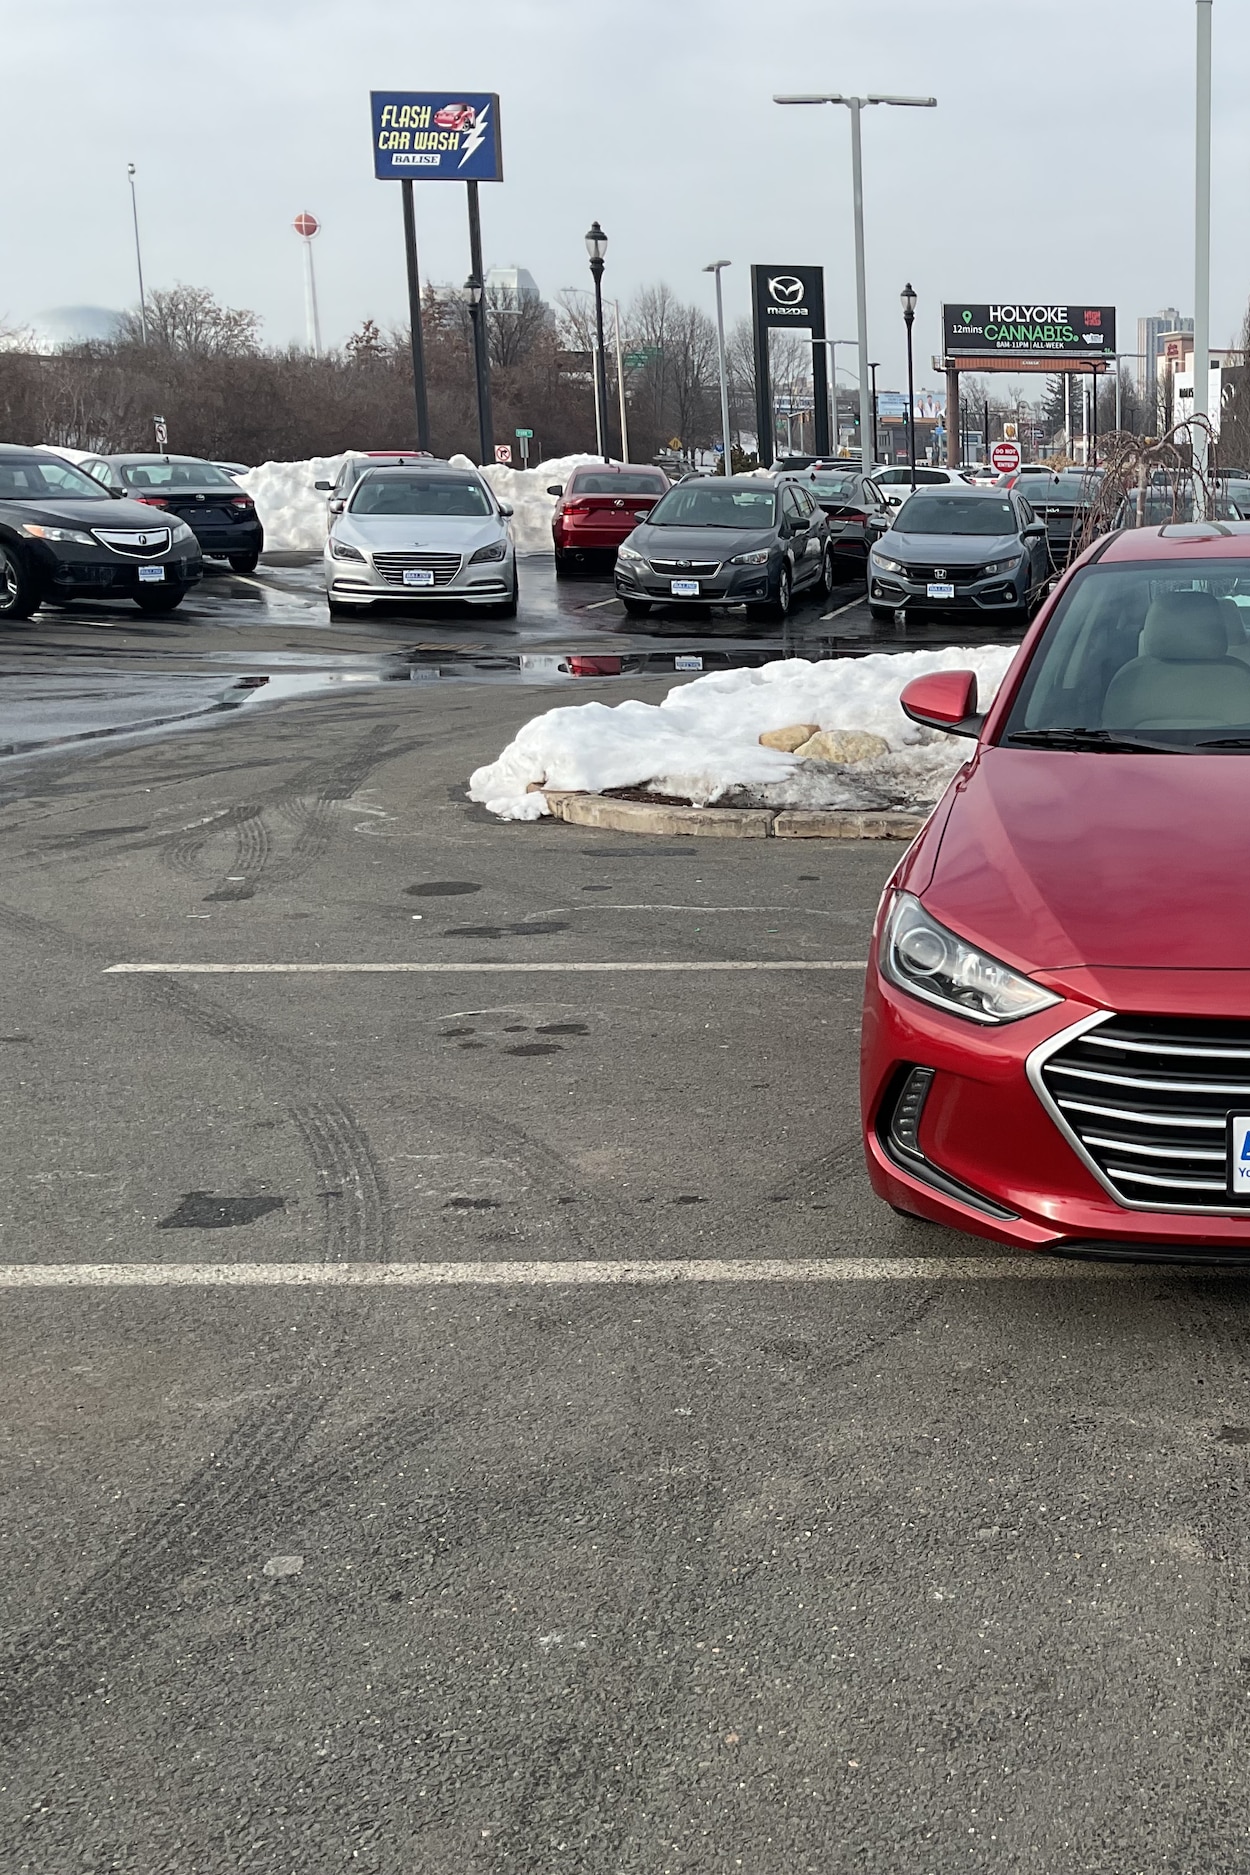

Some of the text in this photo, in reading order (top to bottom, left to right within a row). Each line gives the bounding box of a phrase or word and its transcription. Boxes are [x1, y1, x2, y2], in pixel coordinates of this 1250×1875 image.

[381, 105, 431, 128] FLASH
[378, 131, 460, 150] CAR WASH
[394, 154, 439, 164] BALISE
[989, 306, 1068, 323] HOLYOKE
[952, 324, 983, 334] 12mins
